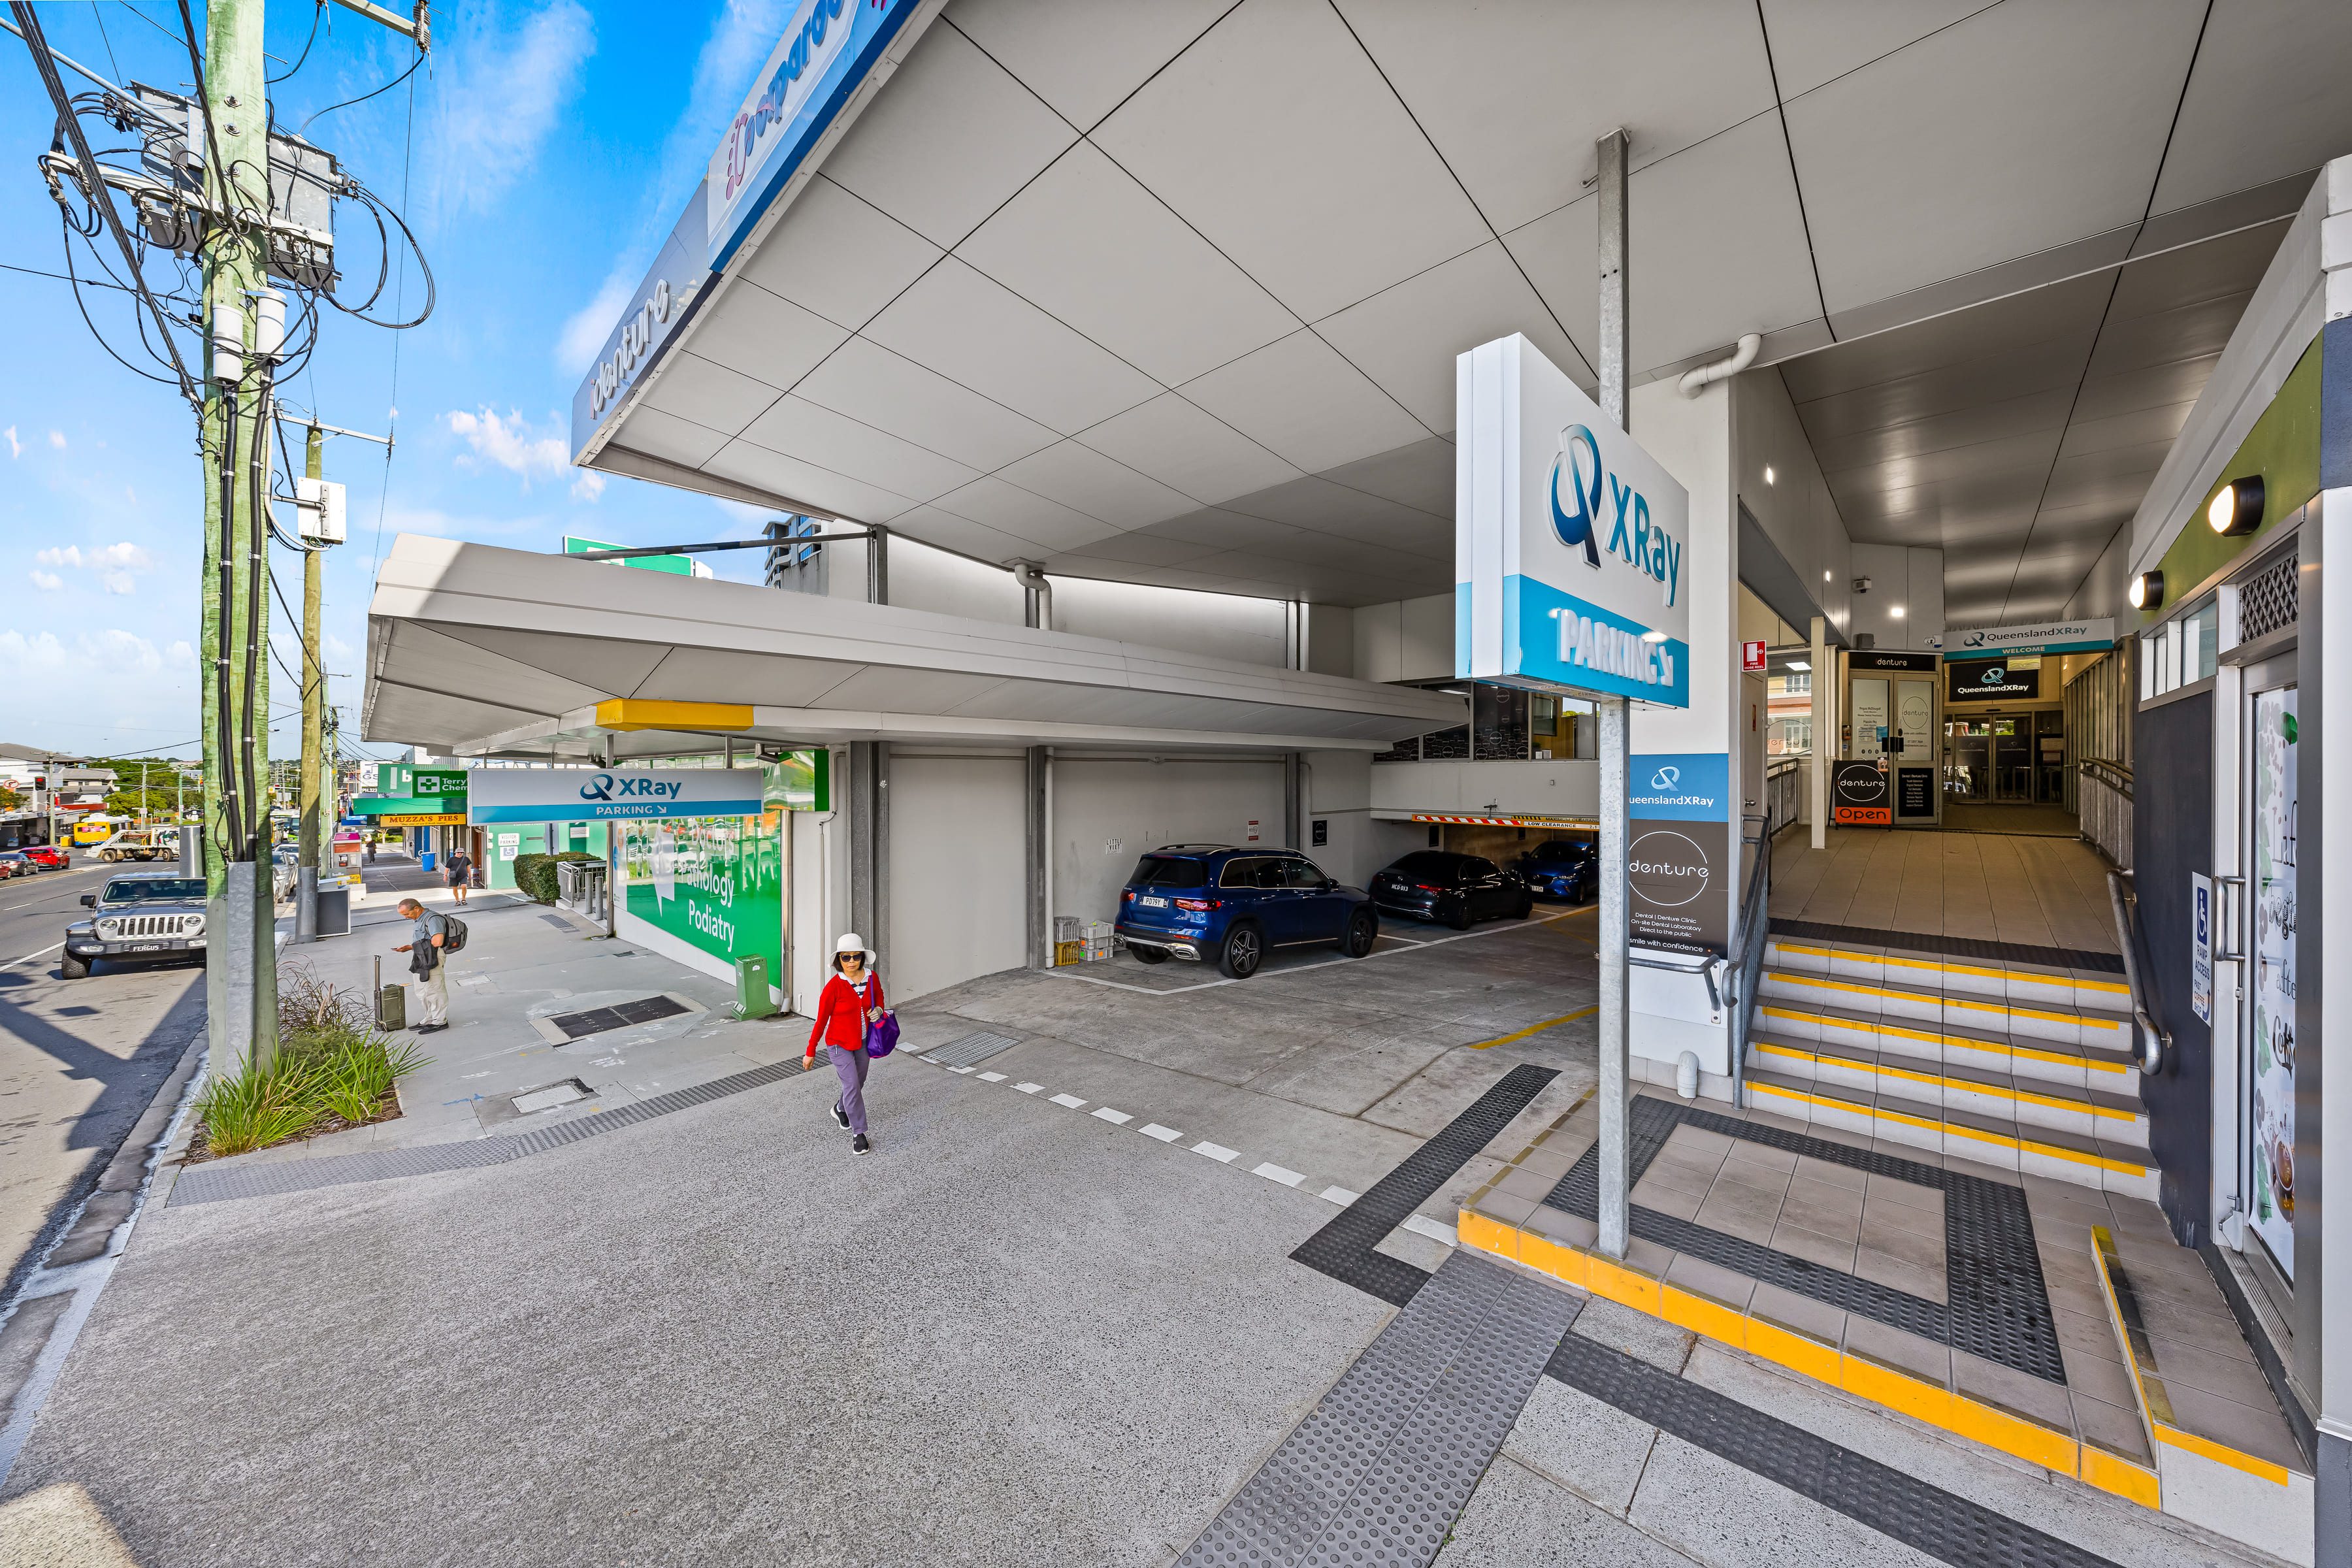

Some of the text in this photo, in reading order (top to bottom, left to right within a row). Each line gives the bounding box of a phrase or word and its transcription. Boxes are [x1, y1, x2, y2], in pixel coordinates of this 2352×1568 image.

[1605, 471, 1680, 608] XRay
[1987, 627, 2087, 641] QueenslandXRay
[1558, 609, 1658, 682] PARKING
[1957, 685, 2029, 694] QueenslandXRay
[617, 778, 682, 800] XRay
[1629, 794, 1714, 808] ueenslandXRay
[596, 806, 653, 815] PARKING
[1839, 808, 1886, 821] Open
[2272, 800, 2297, 868] Lif
[689, 898, 734, 953] Podiatry
[1671, 923, 1702, 932] Laboratory
[1662, 942, 1703, 952] confidence
[2197, 945, 2208, 961] RAMP
[2195, 958, 2210, 980] ACCESS
